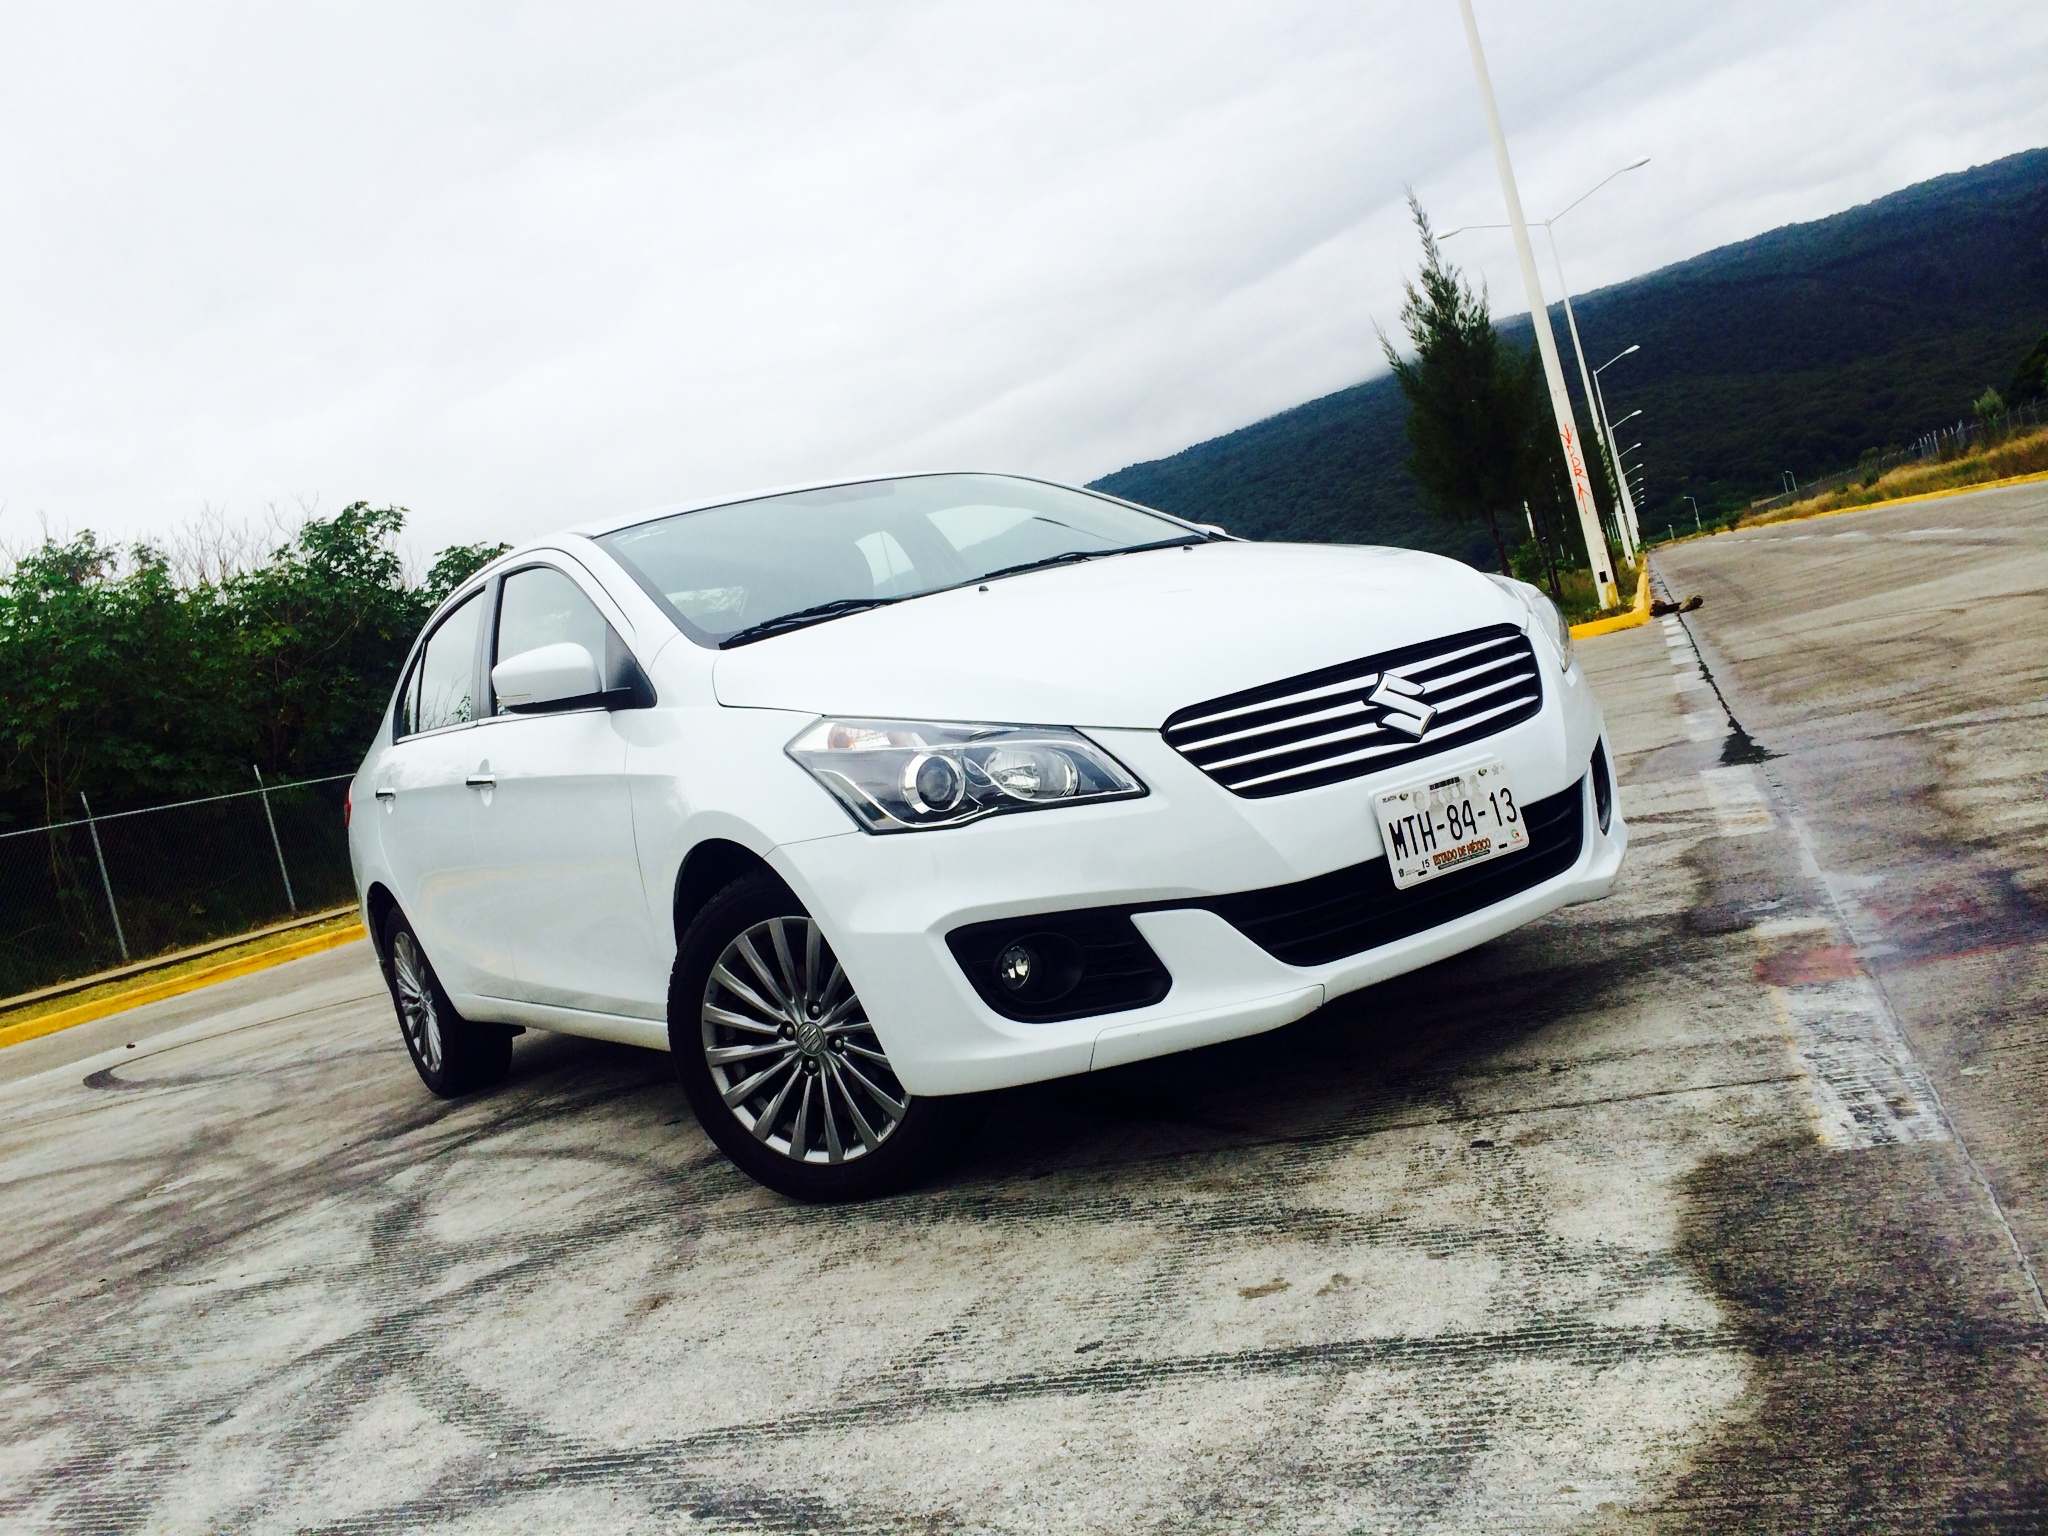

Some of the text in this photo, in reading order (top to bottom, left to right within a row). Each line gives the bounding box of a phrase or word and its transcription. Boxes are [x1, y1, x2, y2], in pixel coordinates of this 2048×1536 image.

[1388, 787, 1518, 861] MTH-84-13
[1432, 848, 1458, 866] ESTADO
[1458, 846, 1467, 858] DE
